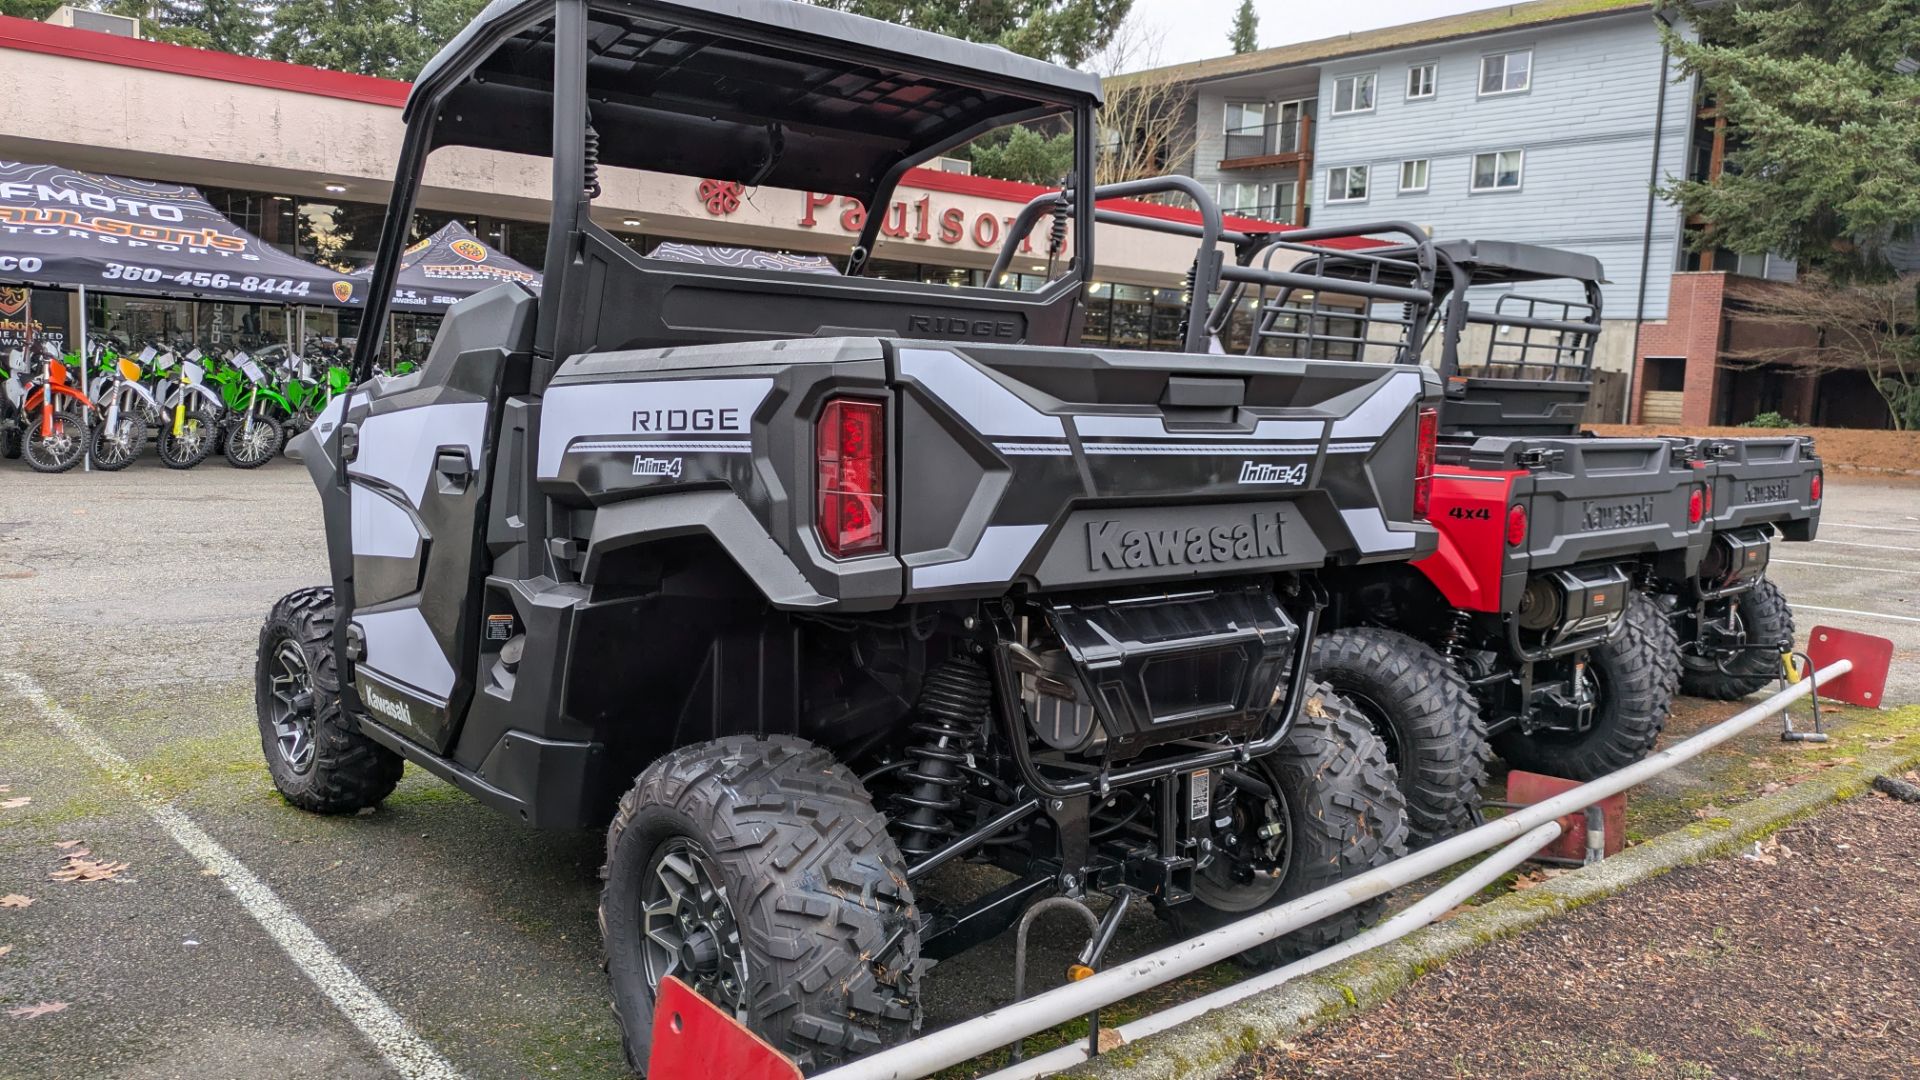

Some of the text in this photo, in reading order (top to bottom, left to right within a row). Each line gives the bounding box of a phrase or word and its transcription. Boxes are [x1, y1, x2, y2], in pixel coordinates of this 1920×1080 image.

[799, 190, 1068, 255] Paulso
[102, 263, 310, 297] 360-456-8444
[391, 296, 427, 305] awasaki
[908, 314, 1015, 338] RIDGE
[632, 409, 739, 431] RIDGE
[1448, 507, 1491, 520] 4x4
[1581, 497, 1655, 531] Kawasaki
[1085, 512, 1290, 572] Kawasaki
[365, 684, 412, 726] Kawasaki
